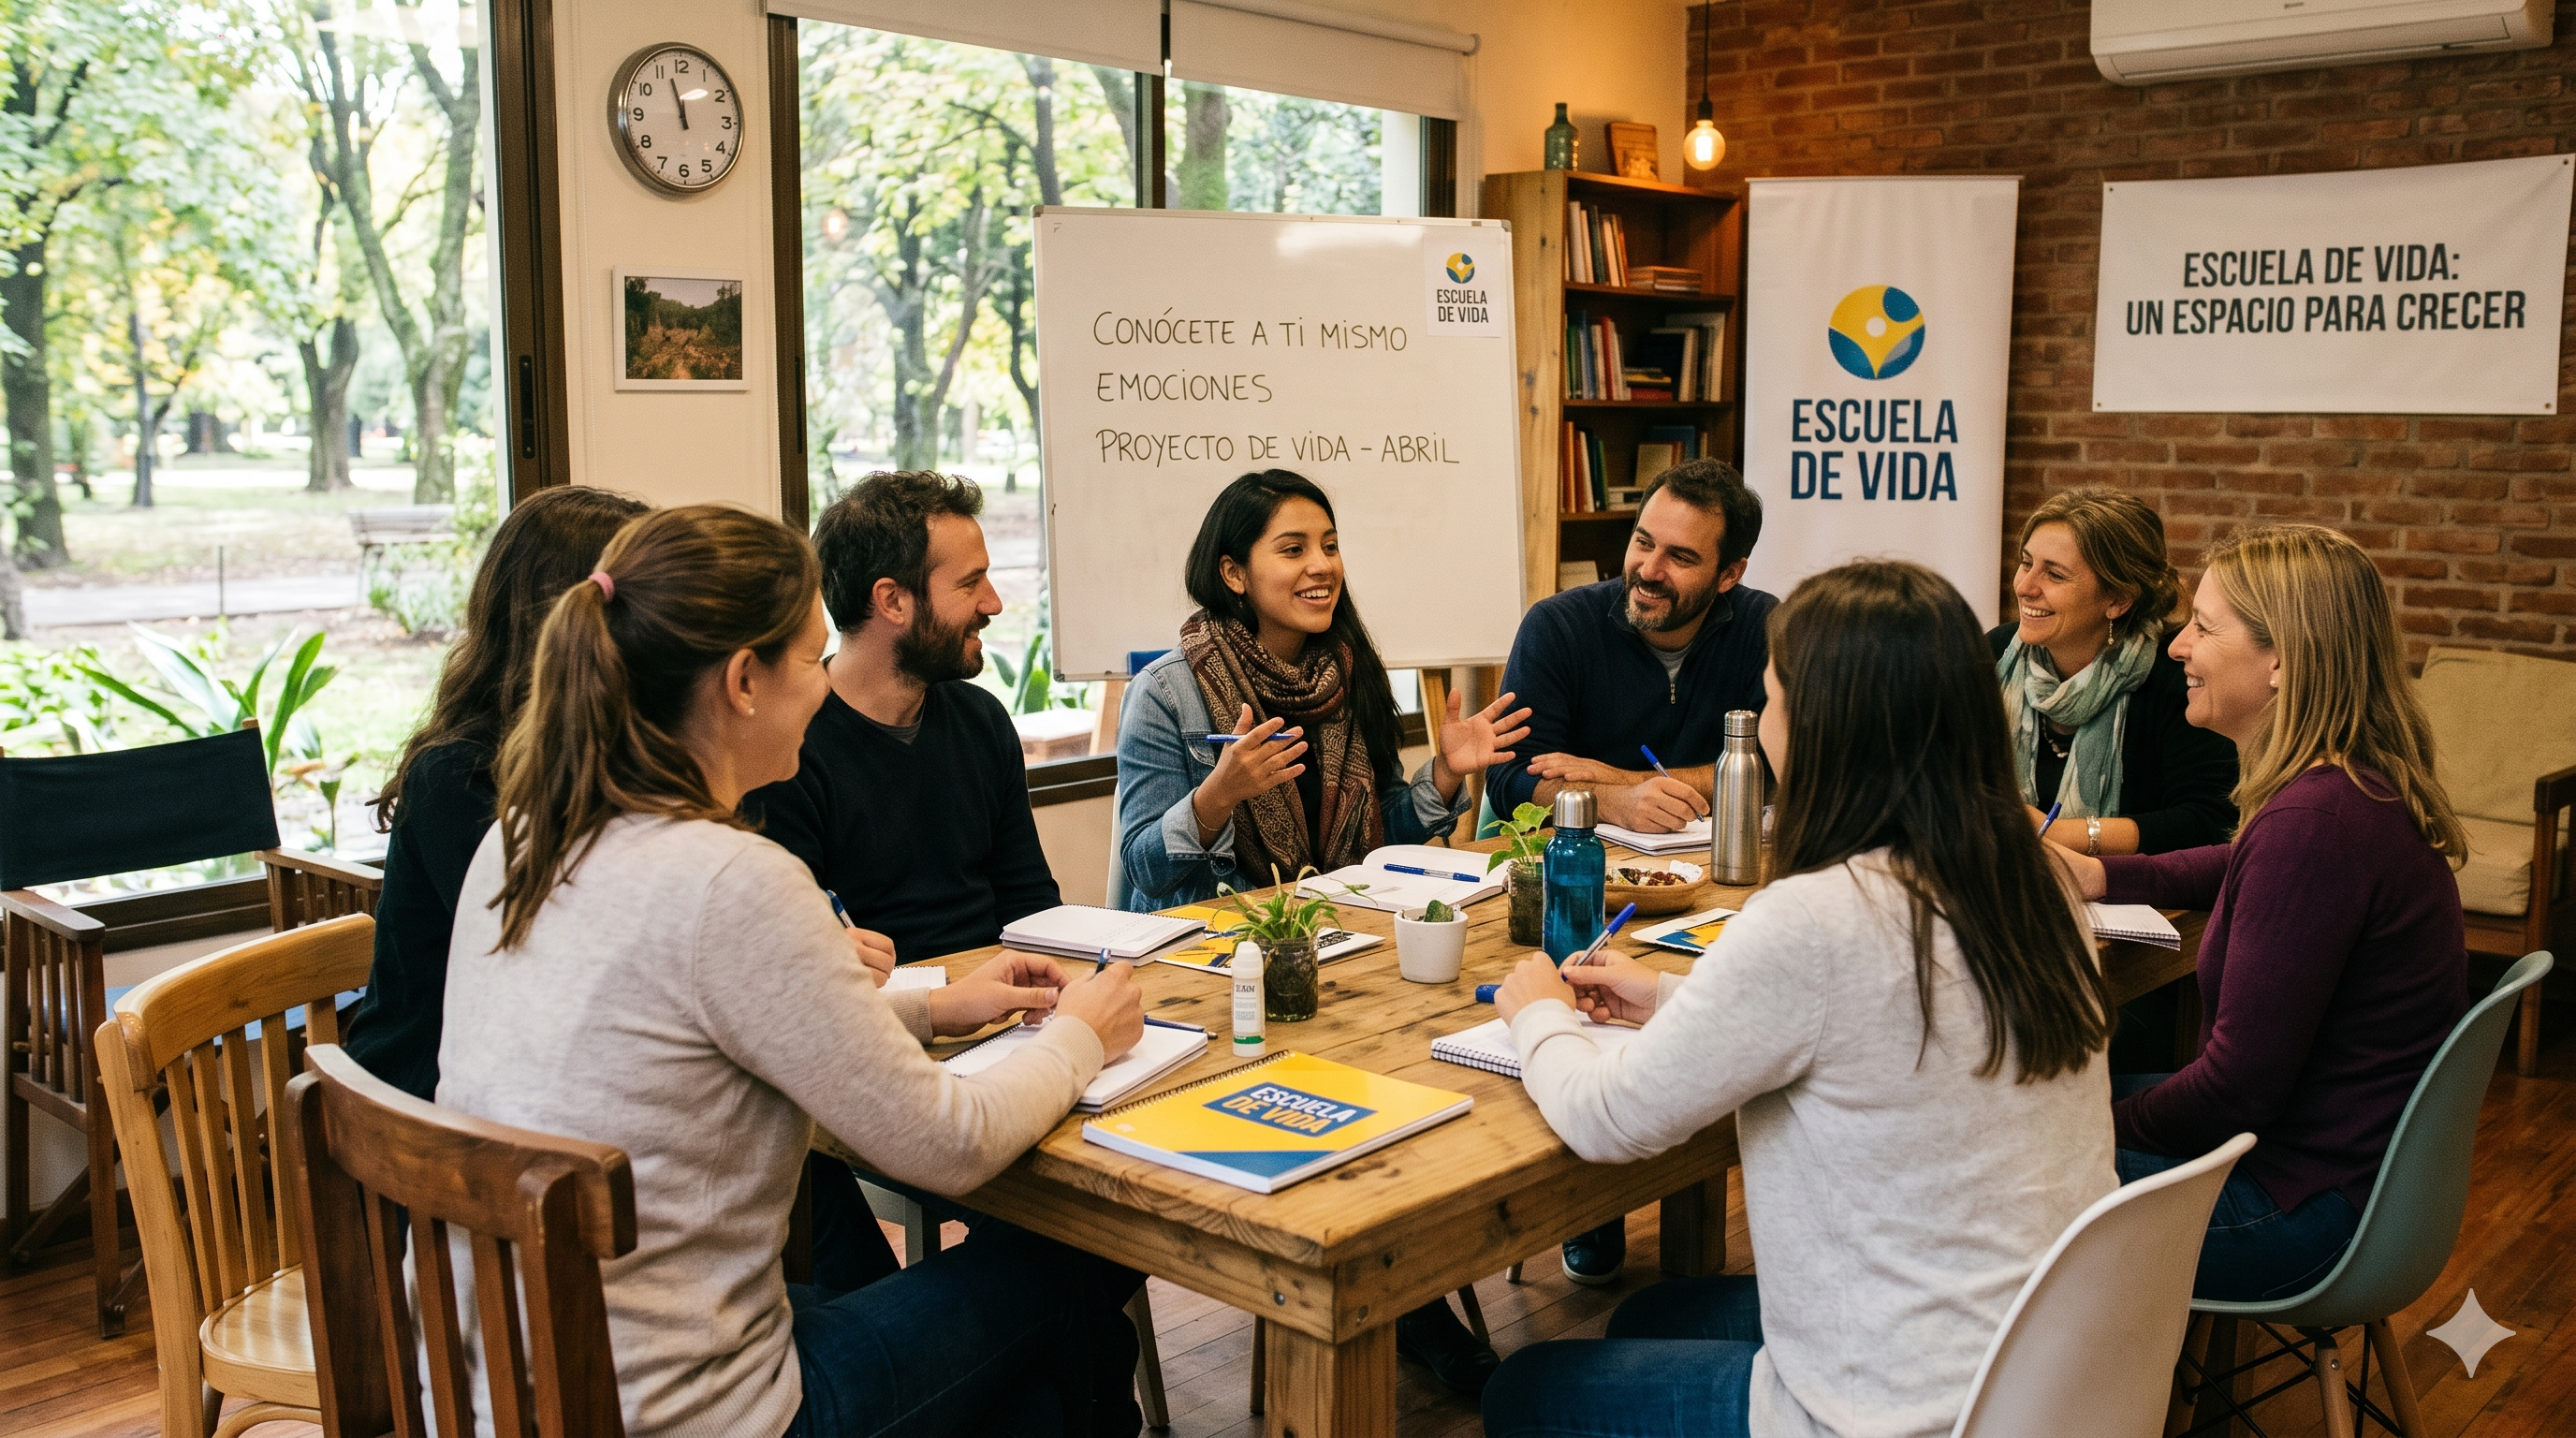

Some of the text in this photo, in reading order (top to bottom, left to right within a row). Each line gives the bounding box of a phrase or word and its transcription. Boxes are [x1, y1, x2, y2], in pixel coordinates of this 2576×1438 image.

[655, 65, 664, 79] 11
[674, 59, 689, 73] 12
[639, 82, 652, 96] 10
[714, 89, 725, 103] 2
[633, 107, 645, 122] 9
[721, 116, 732, 130] 3
[640, 134, 652, 149] 8
[715, 140, 726, 154] 4
[656, 155, 668, 169] 7
[701, 159, 713, 173] 5
[679, 164, 690, 178] 6
[2183, 242, 2460, 288] ESCUELA DE VIDA:
[1436, 288, 1487, 305] ESCUELA
[1438, 305, 1489, 324] DE VIDA
[2126, 289, 2527, 336] UN ESPACIO PARA CRECER
[1093, 307, 1236, 345] CONÓCETE
[1251, 320, 1268, 346] A
[1792, 398, 1958, 444] ESCUELA
[1095, 429, 1235, 468] PROYECTO
[1247, 434, 1281, 461] DE
[1791, 450, 1958, 502] DE VIDA
[1251, 1086, 1357, 1123] ESCUELA
[1222, 1095, 1333, 1134] DE VIDA
